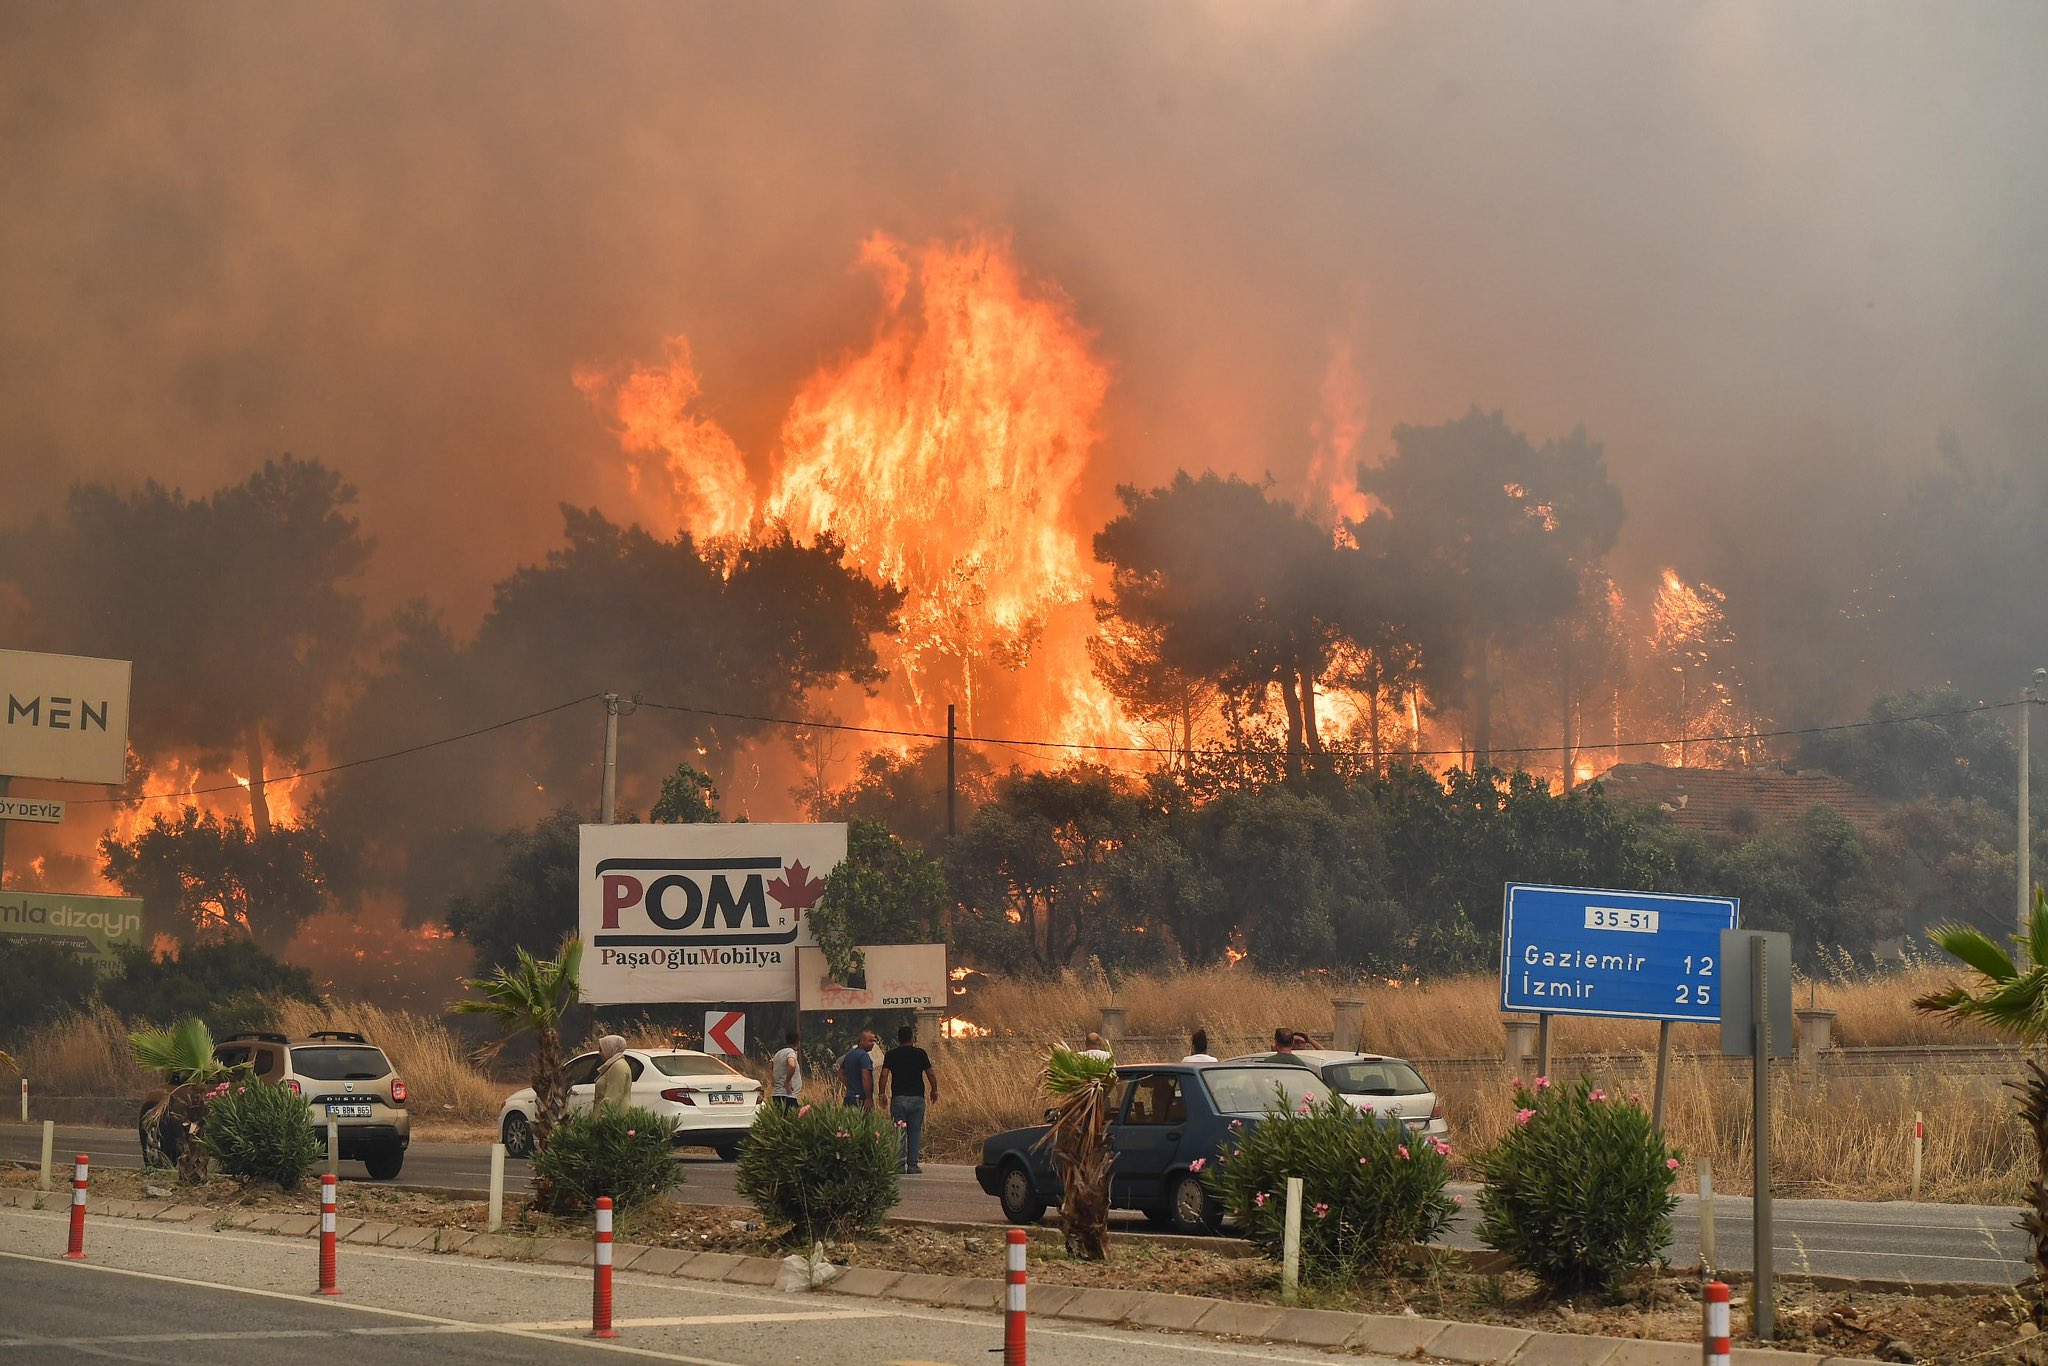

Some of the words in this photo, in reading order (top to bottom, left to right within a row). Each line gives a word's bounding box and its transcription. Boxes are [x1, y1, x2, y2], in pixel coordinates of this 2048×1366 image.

[8, 693, 108, 732] MEN
[601, 874, 770, 931] POM
[1594, 911, 1650, 929] 35-51
[1524, 945, 1646, 972] Gaziemir
[1683, 956, 1714, 976] 12
[1523, 971, 1595, 999] İzmir
[1675, 984, 1711, 1006] 25
